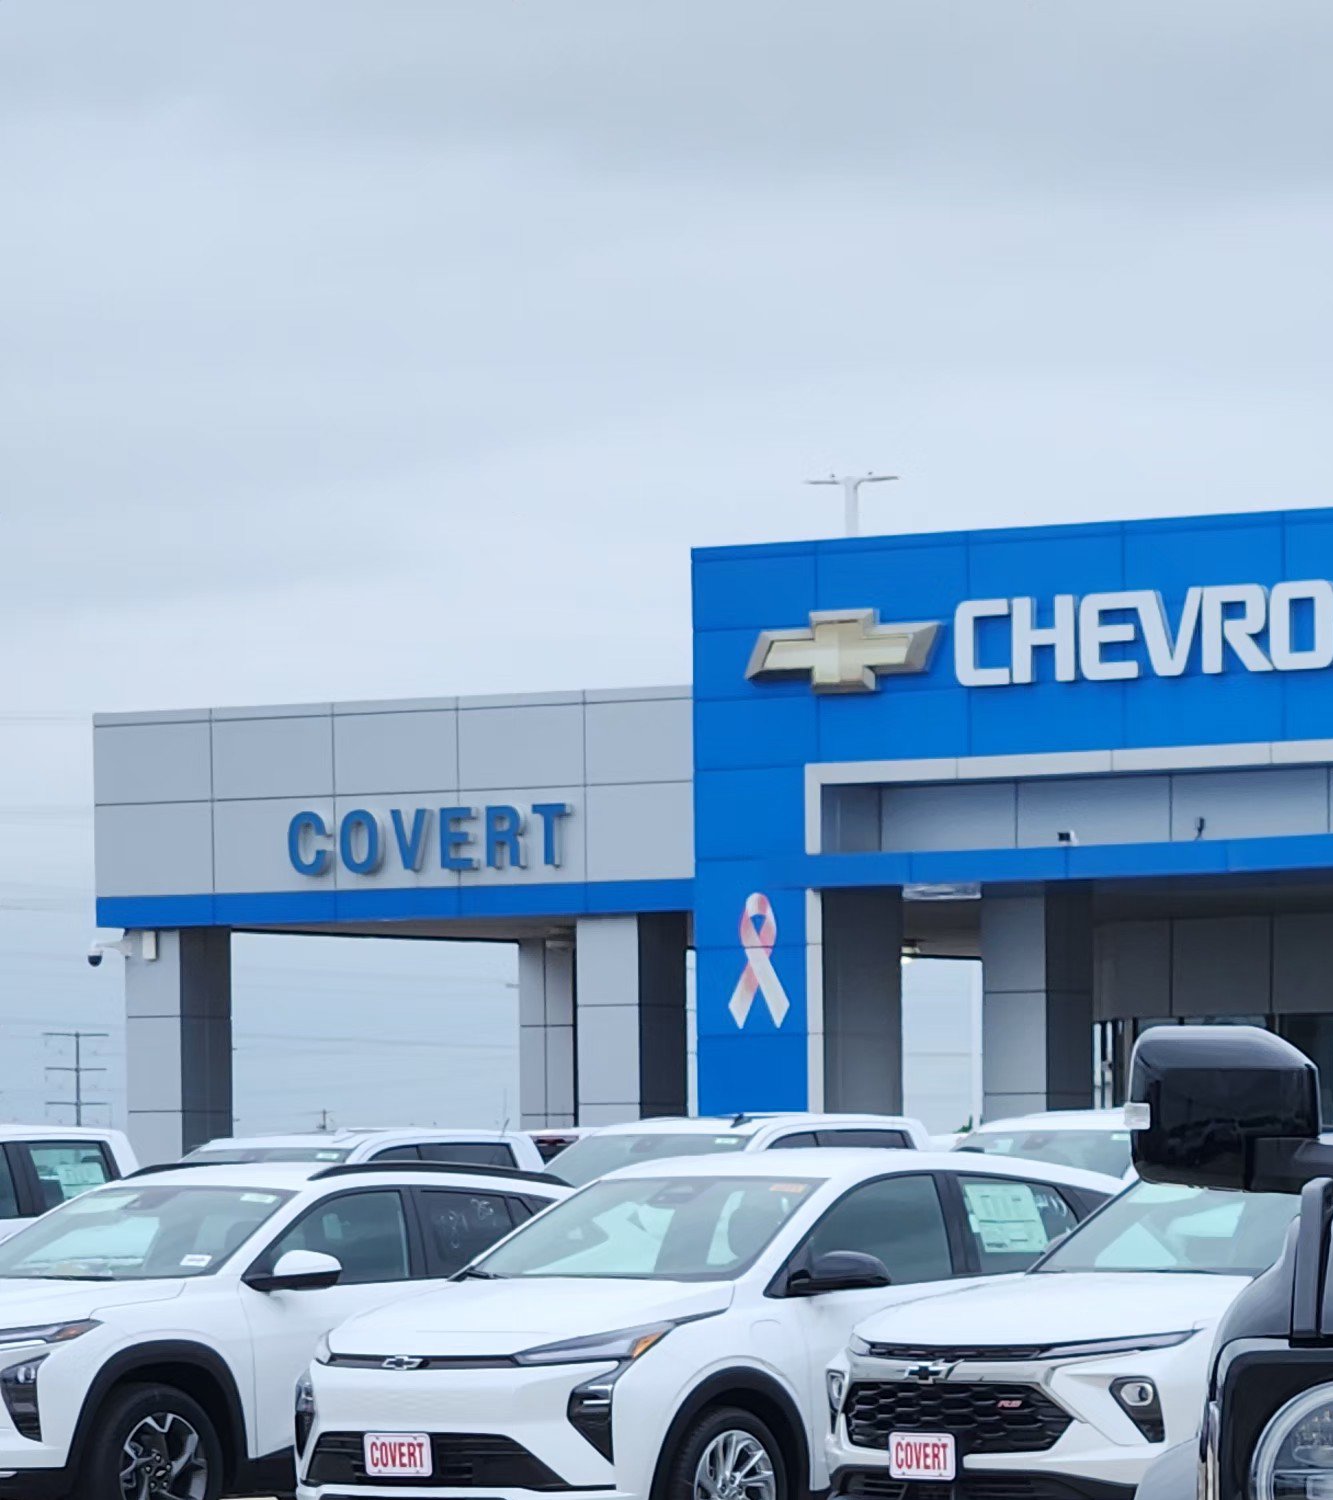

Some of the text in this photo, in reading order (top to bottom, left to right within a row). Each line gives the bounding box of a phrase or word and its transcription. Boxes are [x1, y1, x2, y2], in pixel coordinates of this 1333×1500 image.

[287, 803, 573, 876] COVERT
[370, 1441, 424, 1468] COVERT
[895, 1441, 949, 1470] COVERT
